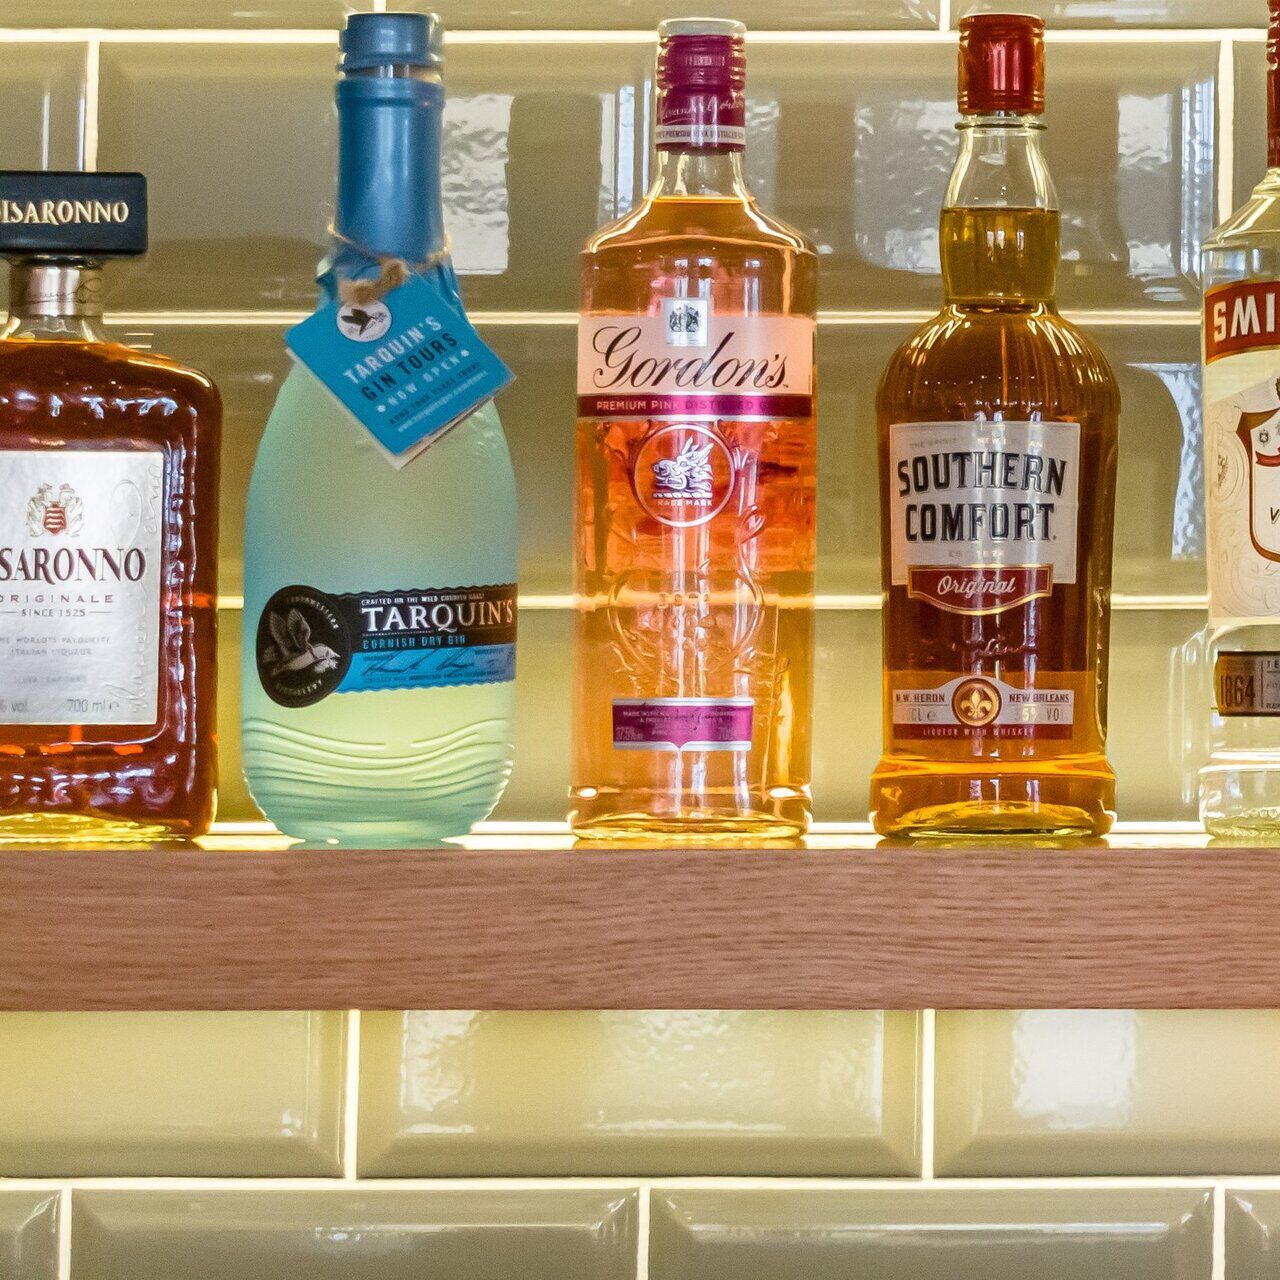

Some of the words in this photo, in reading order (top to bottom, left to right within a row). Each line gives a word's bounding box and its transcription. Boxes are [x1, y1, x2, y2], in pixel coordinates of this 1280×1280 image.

[0, 200, 129, 225] ISARONNO
[343, 316, 442, 384] TARQUIN'S
[592, 326, 787, 389] Gordon's
[361, 372, 397, 401] GIN
[397, 333, 458, 375] TOURS
[596, 401, 647, 410] PREMIUM
[651, 401, 680, 410] PINK
[897, 452, 1067, 497] SOUTHERN
[655, 499, 683, 507] RADE
[685, 499, 712, 507] MARK
[937, 575, 1017, 599] Original
[361, 599, 513, 633] TARQUIN'S
[362, 637, 416, 650] CORNISH
[421, 636, 442, 647] DRY
[913, 693, 945, 703] HERON
[1009, 693, 1030, 703] NEW
[1033, 693, 1070, 703] ORLEANS
[1220, 675, 1256, 708] 1864
